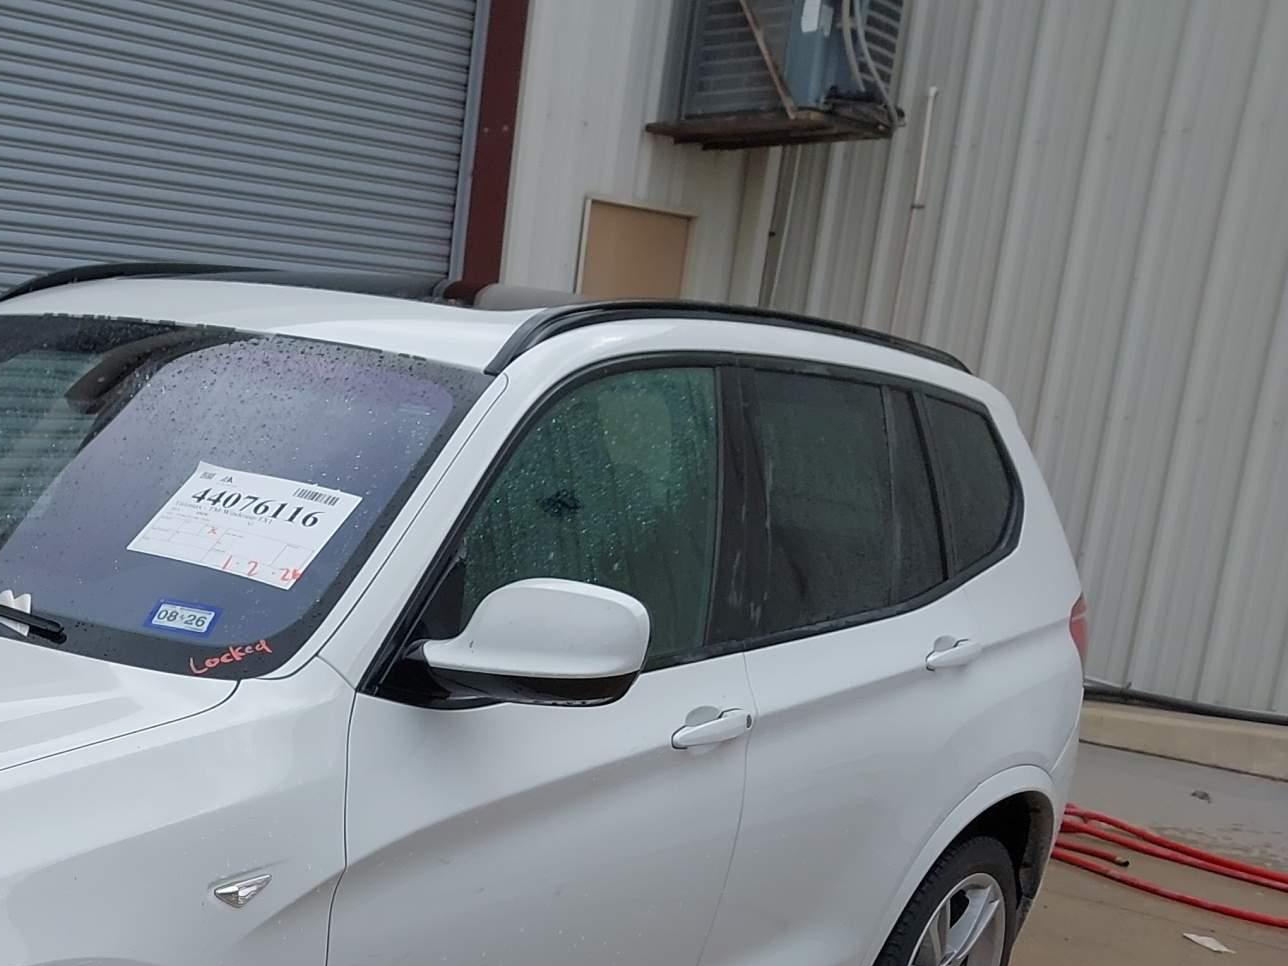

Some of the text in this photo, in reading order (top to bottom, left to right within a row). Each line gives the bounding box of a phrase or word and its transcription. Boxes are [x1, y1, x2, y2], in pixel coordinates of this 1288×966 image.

[191, 487, 326, 528] 44076116
[157, 609, 179, 622] 08
[183, 614, 208, 628] 26
[189, 639, 273, 674] Locked
